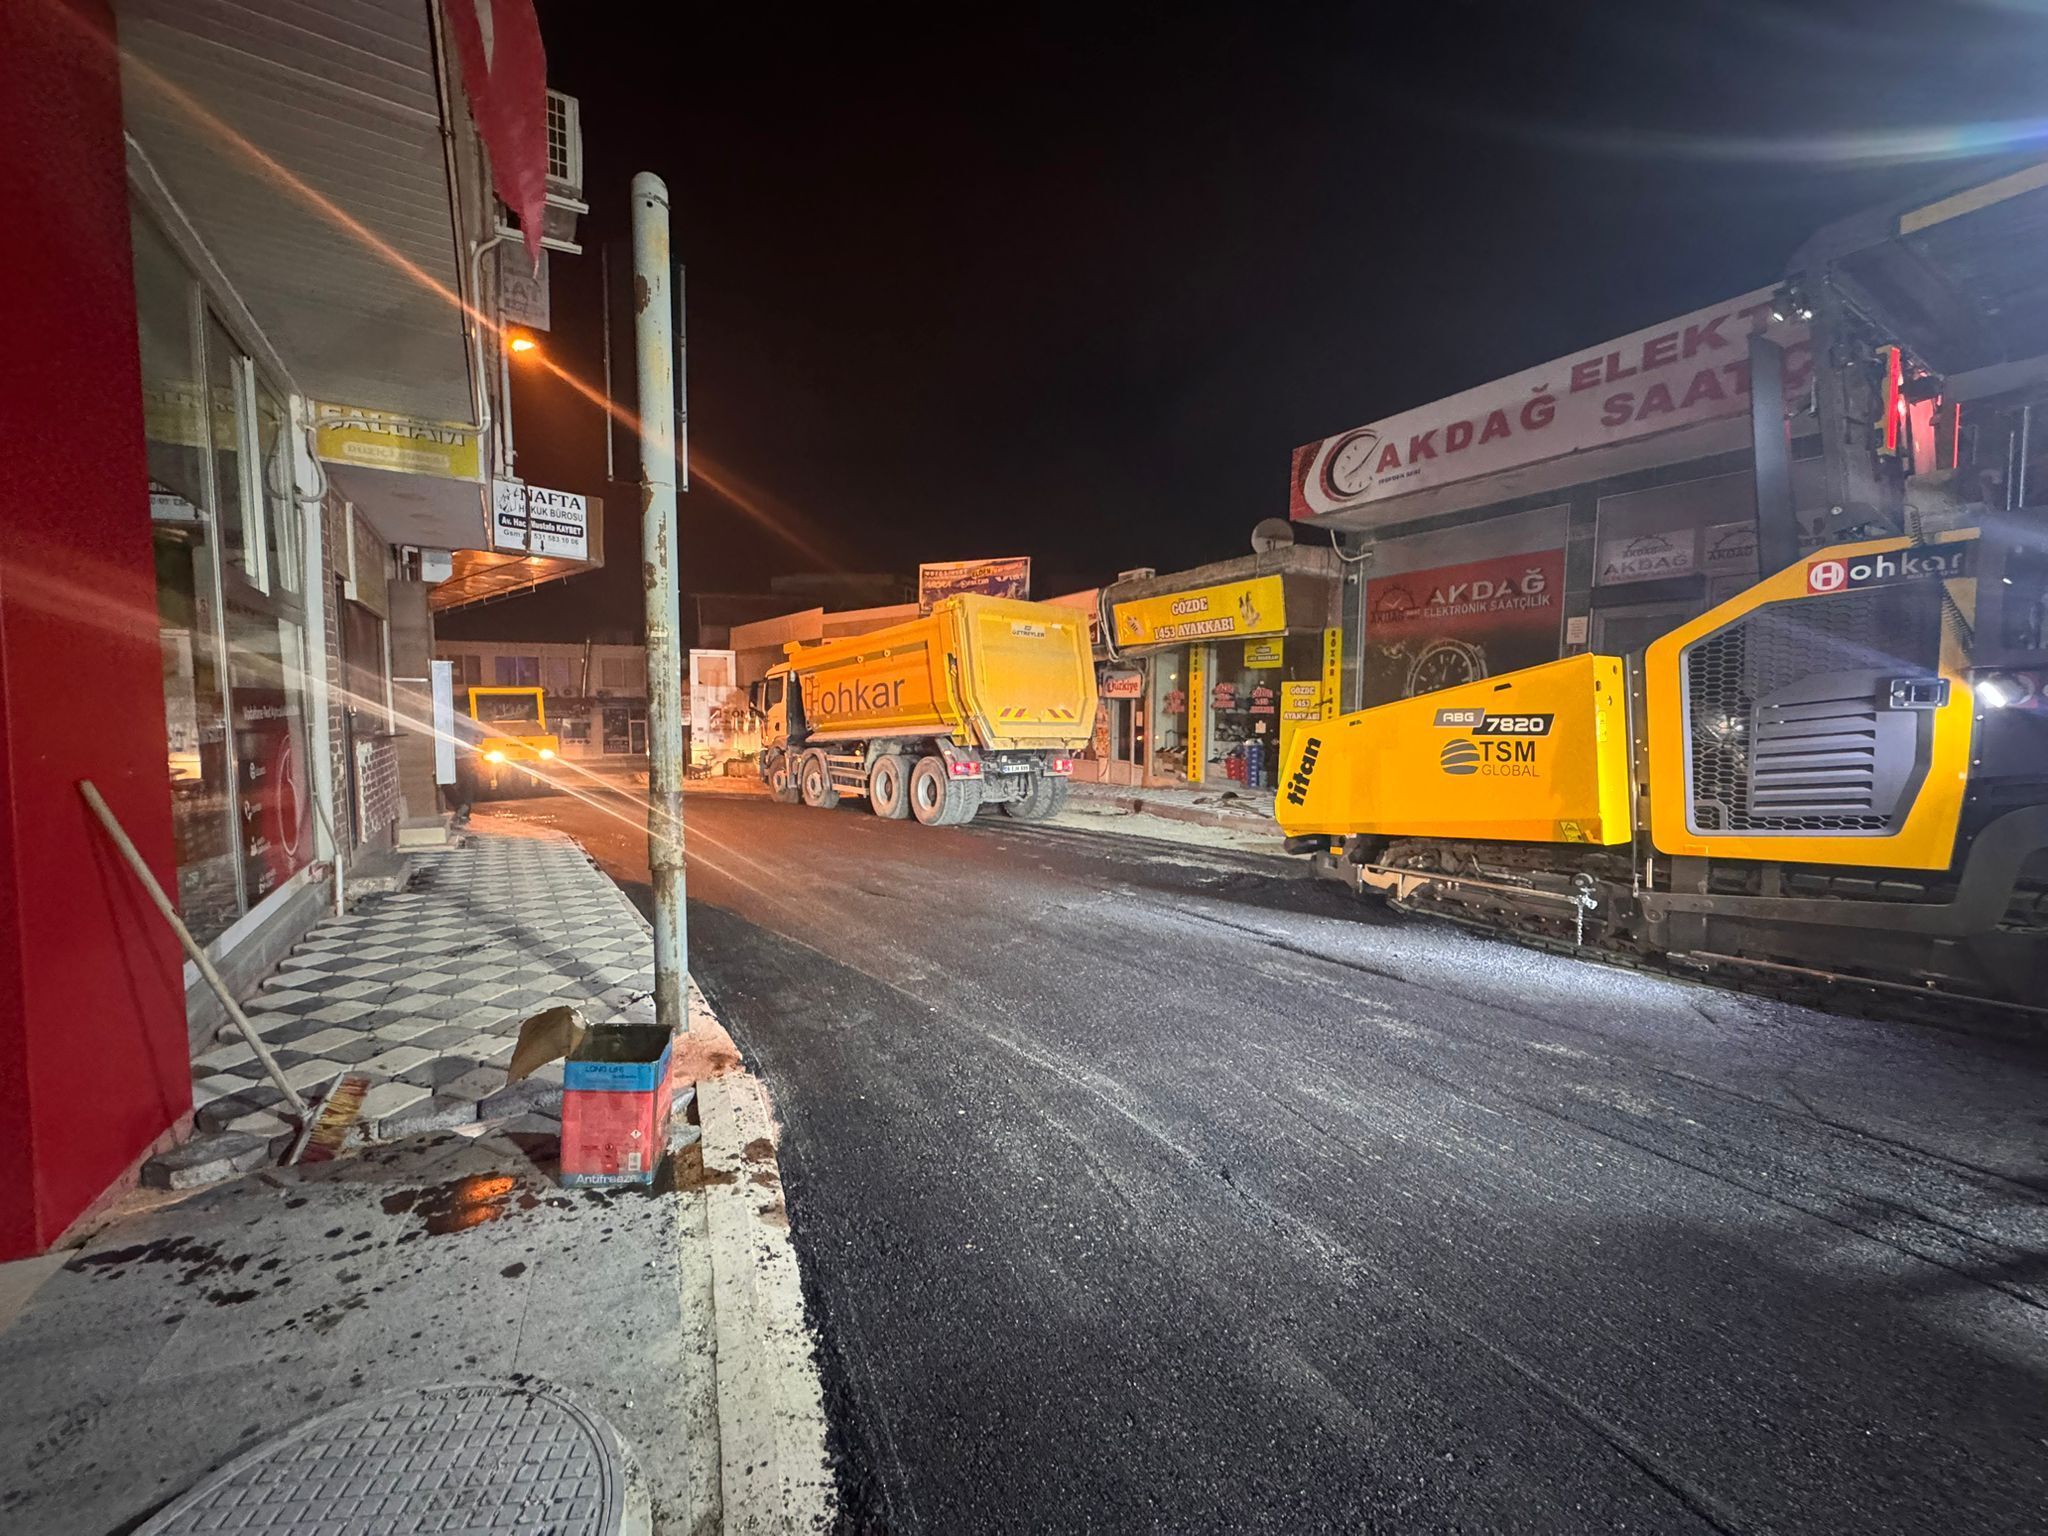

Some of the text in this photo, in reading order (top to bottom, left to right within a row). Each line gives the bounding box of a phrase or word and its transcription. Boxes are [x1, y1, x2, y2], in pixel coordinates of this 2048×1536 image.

[1375, 382, 1556, 475] AKDAĞ
[520, 488, 581, 510] NAFTA
[513, 518, 527, 528] Hac
[519, 504, 583, 522] HKUK BÜROSU
[1603, 555, 1689, 576] AKDAĞ
[1850, 552, 1963, 581] ohkar
[1426, 567, 1546, 607] AKDAĞ
[1171, 597, 1208, 616] GÖZDE
[1423, 594, 1550, 617] ELEKTRONİK SAATÇİLİK
[1154, 617, 1235, 640] 1453 AYAKKABI
[1290, 685, 1315, 695] GÖZDE
[1443, 712, 1474, 723] ABG
[1486, 717, 1545, 732] 7820
[1479, 741, 1535, 762] TSM
[1287, 737, 1322, 806] titan
[1481, 764, 1540, 778] GLOBAL
